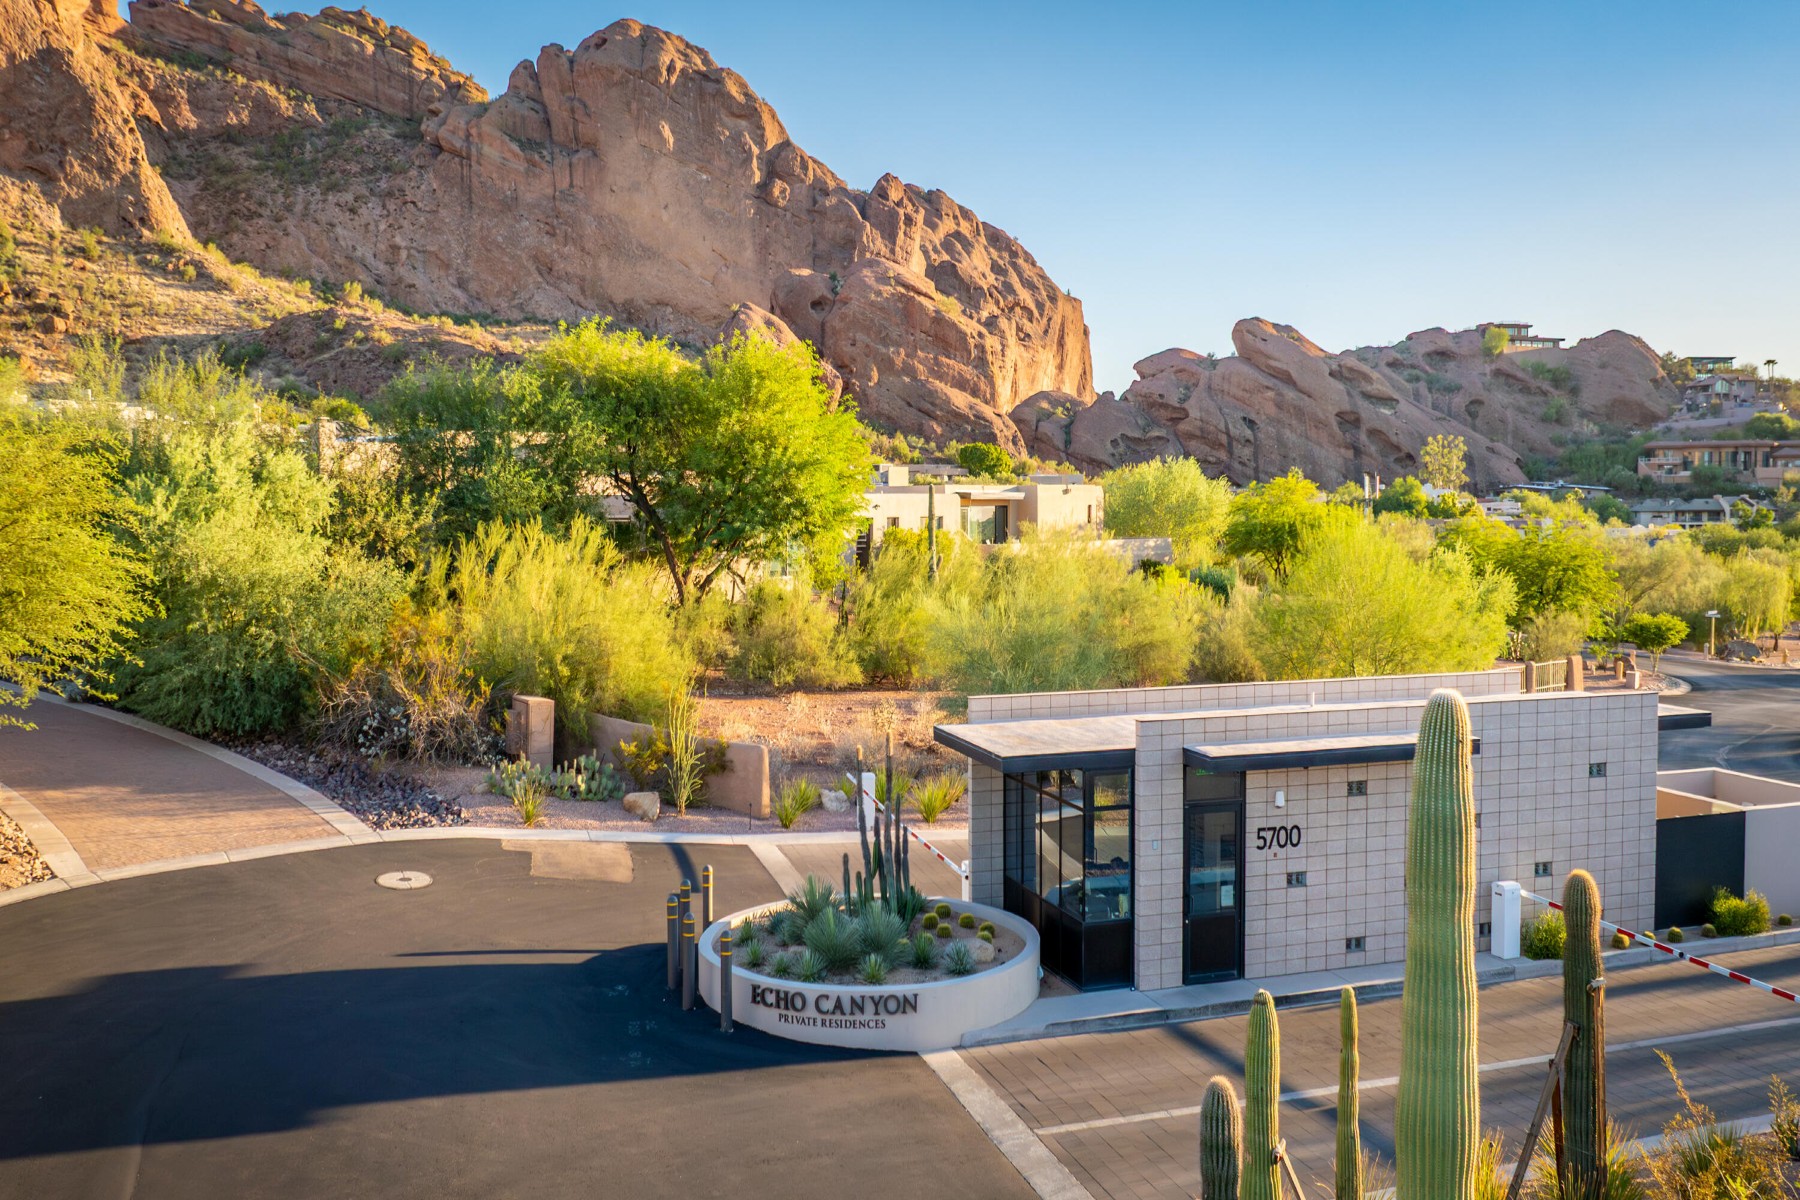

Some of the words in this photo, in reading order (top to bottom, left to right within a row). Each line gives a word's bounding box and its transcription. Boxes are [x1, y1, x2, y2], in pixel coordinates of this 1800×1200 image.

[1256, 824, 1302, 851] 5700
[750, 984, 807, 1012] ECHO
[814, 993, 919, 1016] CANYON
[778, 1013, 818, 1027] PRIVATE
[821, 1018, 886, 1030] RESIDENCES
